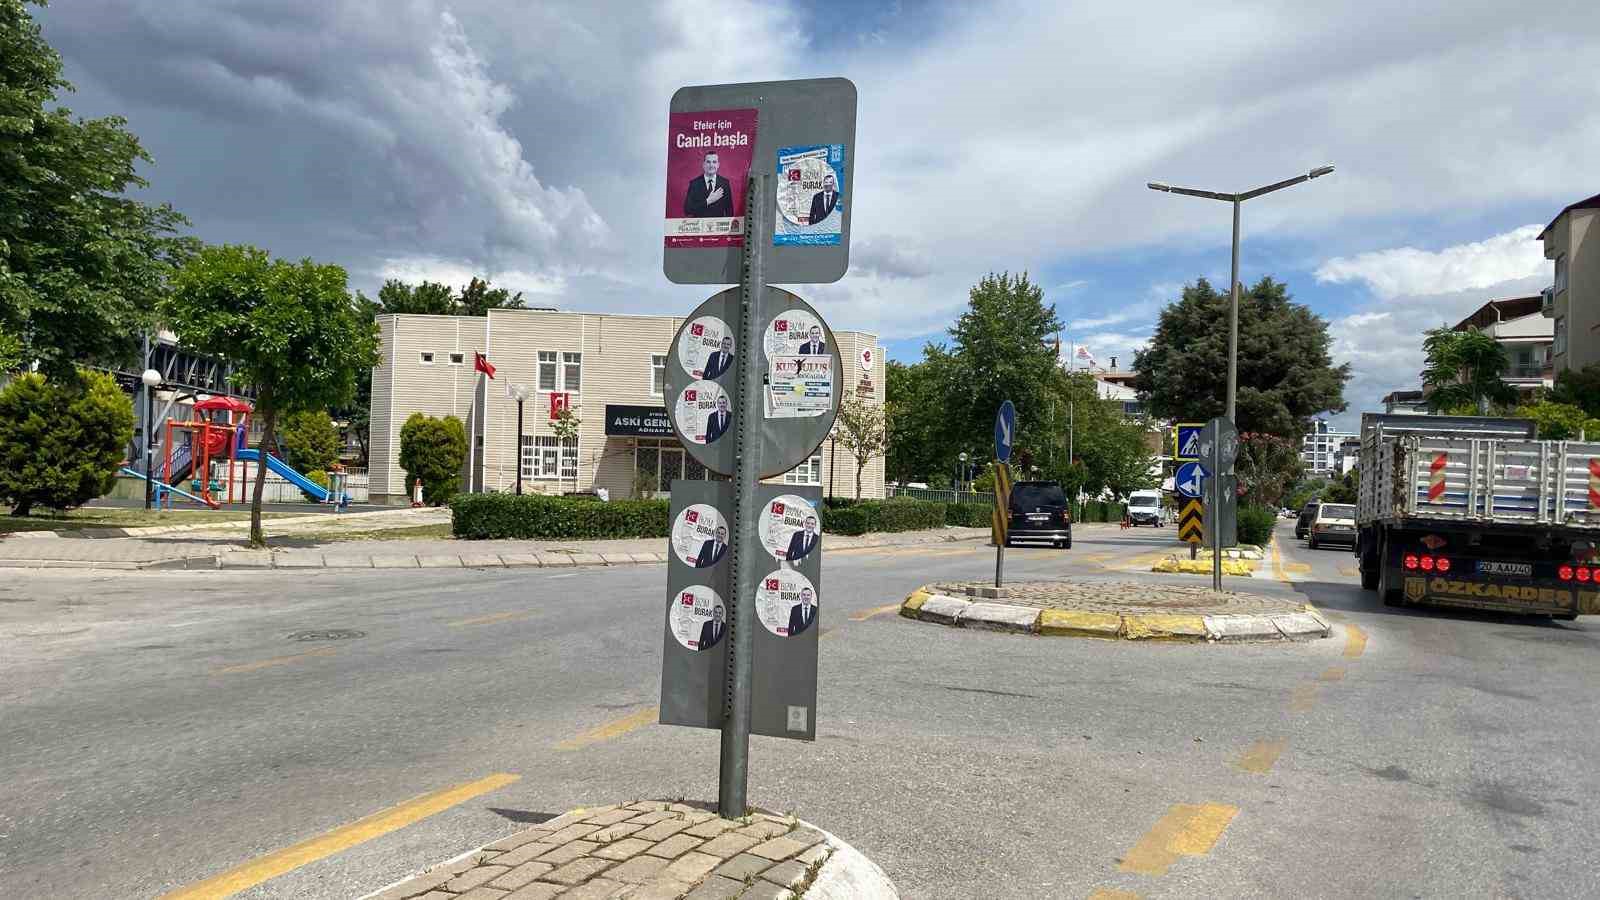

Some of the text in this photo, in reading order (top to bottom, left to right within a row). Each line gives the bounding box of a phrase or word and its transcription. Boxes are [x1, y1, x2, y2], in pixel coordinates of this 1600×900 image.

[693, 120, 717, 130] Efeler
[676, 131, 748, 150] Canla başla
[789, 331, 809, 340] BURAK
[702, 337, 721, 349] BURAK
[698, 401, 717, 410] BURAK
[784, 516, 805, 528] BURAK
[696, 525, 715, 537] BURAK
[780, 591, 801, 601] BURAK
[694, 607, 714, 618] BURAK
